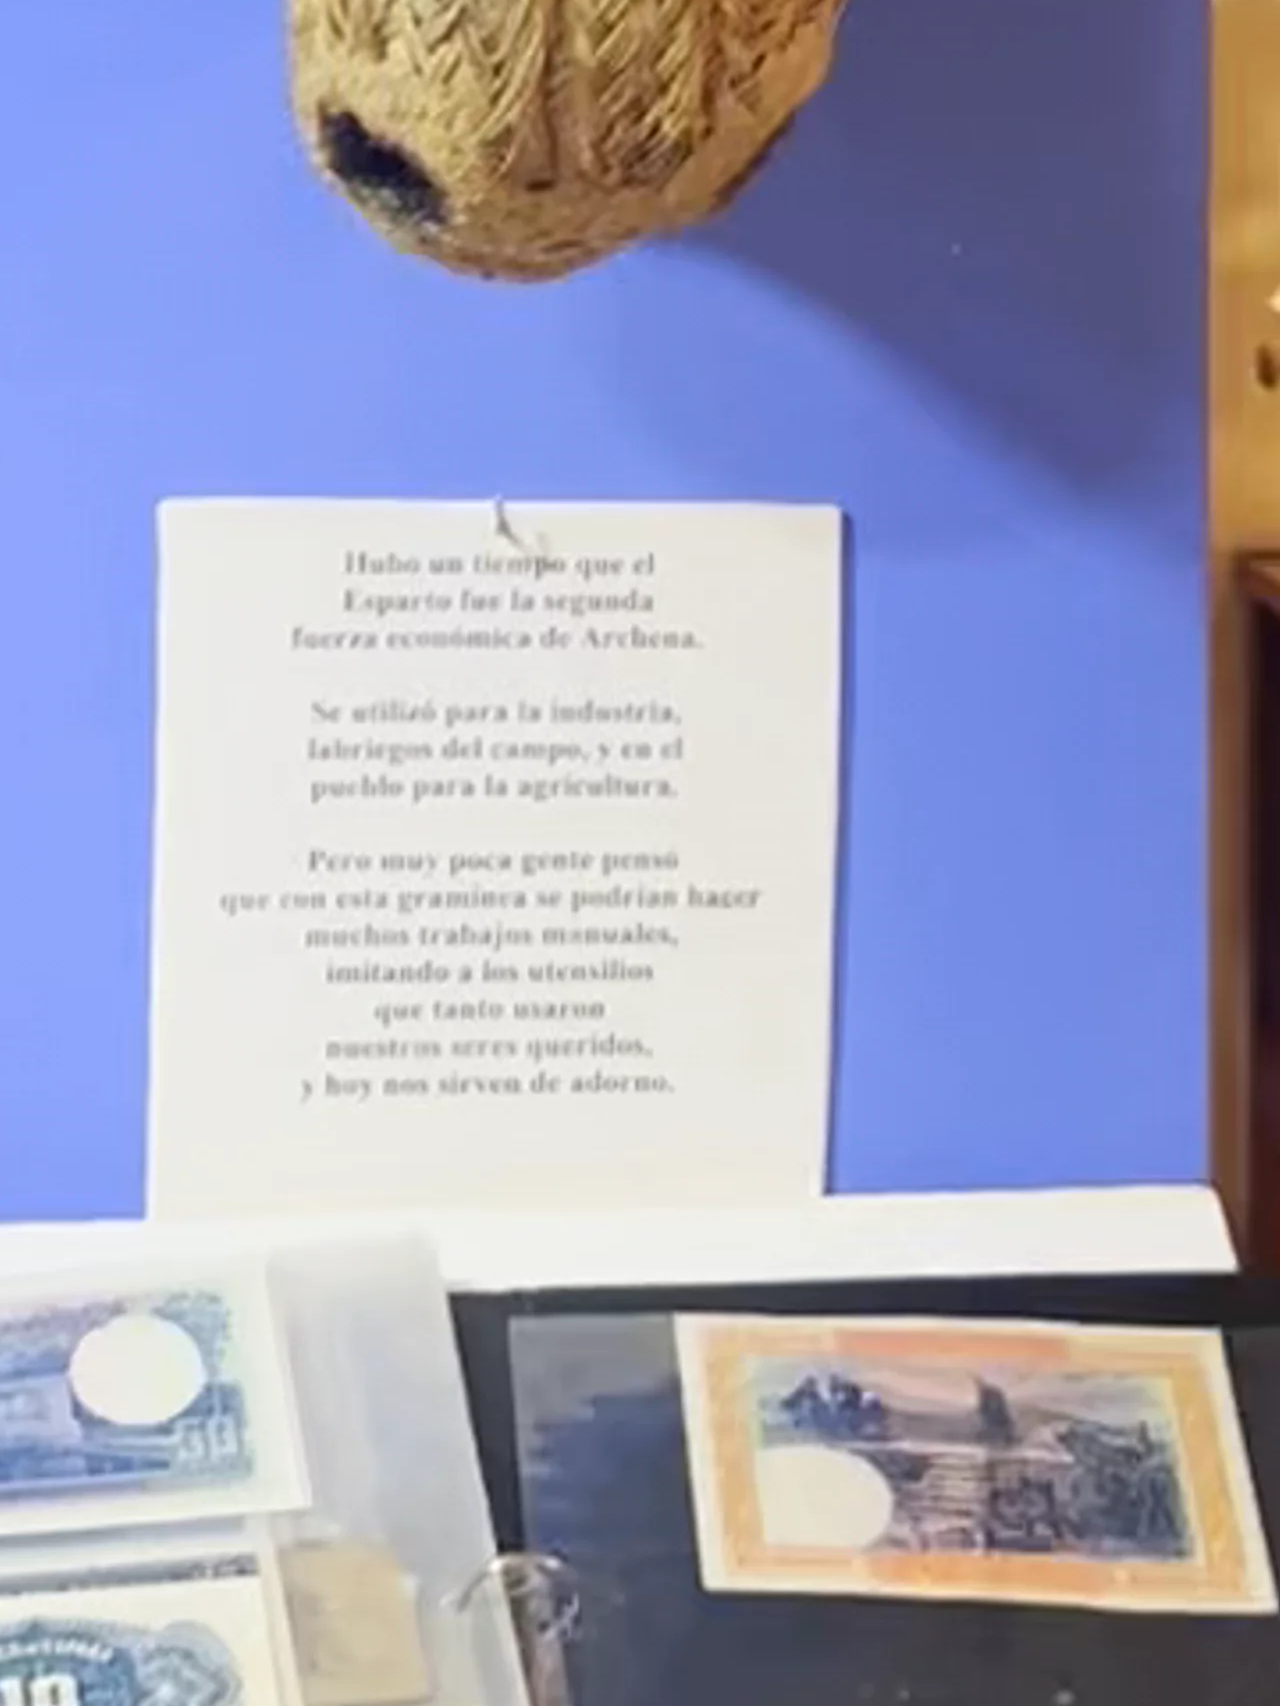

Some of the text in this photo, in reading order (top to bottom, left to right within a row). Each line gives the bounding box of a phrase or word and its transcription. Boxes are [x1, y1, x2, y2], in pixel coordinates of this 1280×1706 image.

[345, 550, 655, 583] Hubo un tiempo que el
[343, 587, 654, 617] Esparto fue la segunda
[291, 624, 703, 650] fuerza económica de Archena.
[311, 698, 682, 729] Se utilizó para la industria,
[307, 737, 433, 767] labriegos
[440, 736, 483, 761] del
[597, 742, 611, 764] y
[620, 742, 652, 760] en
[659, 736, 684, 760] el
[311, 774, 405, 804] pueblo
[412, 779, 476, 804] para
[484, 774, 508, 798] la
[308, 849, 372, 873] Pero
[380, 854, 437, 877] muy
[449, 853, 512, 877] poca
[521, 851, 595, 877] gente
[219, 894, 269, 917] que
[279, 892, 326, 910] con
[335, 889, 389, 910] esta
[536, 891, 562, 908] se
[687, 883, 762, 909] hacer
[305, 921, 679, 953] muchos trabajos manuales,
[326, 958, 654, 984] imitando a los utensilios
[373, 999, 605, 1028] que tanto usaron
[326, 1038, 442, 1059] nuestros
[451, 1040, 518, 1058] seres
[301, 1080, 313, 1103] y
[325, 1072, 372, 1102] hoy
[383, 1078, 430, 1096] nos
[438, 1071, 523, 1095] sirven
[529, 1070, 561, 1094] de
